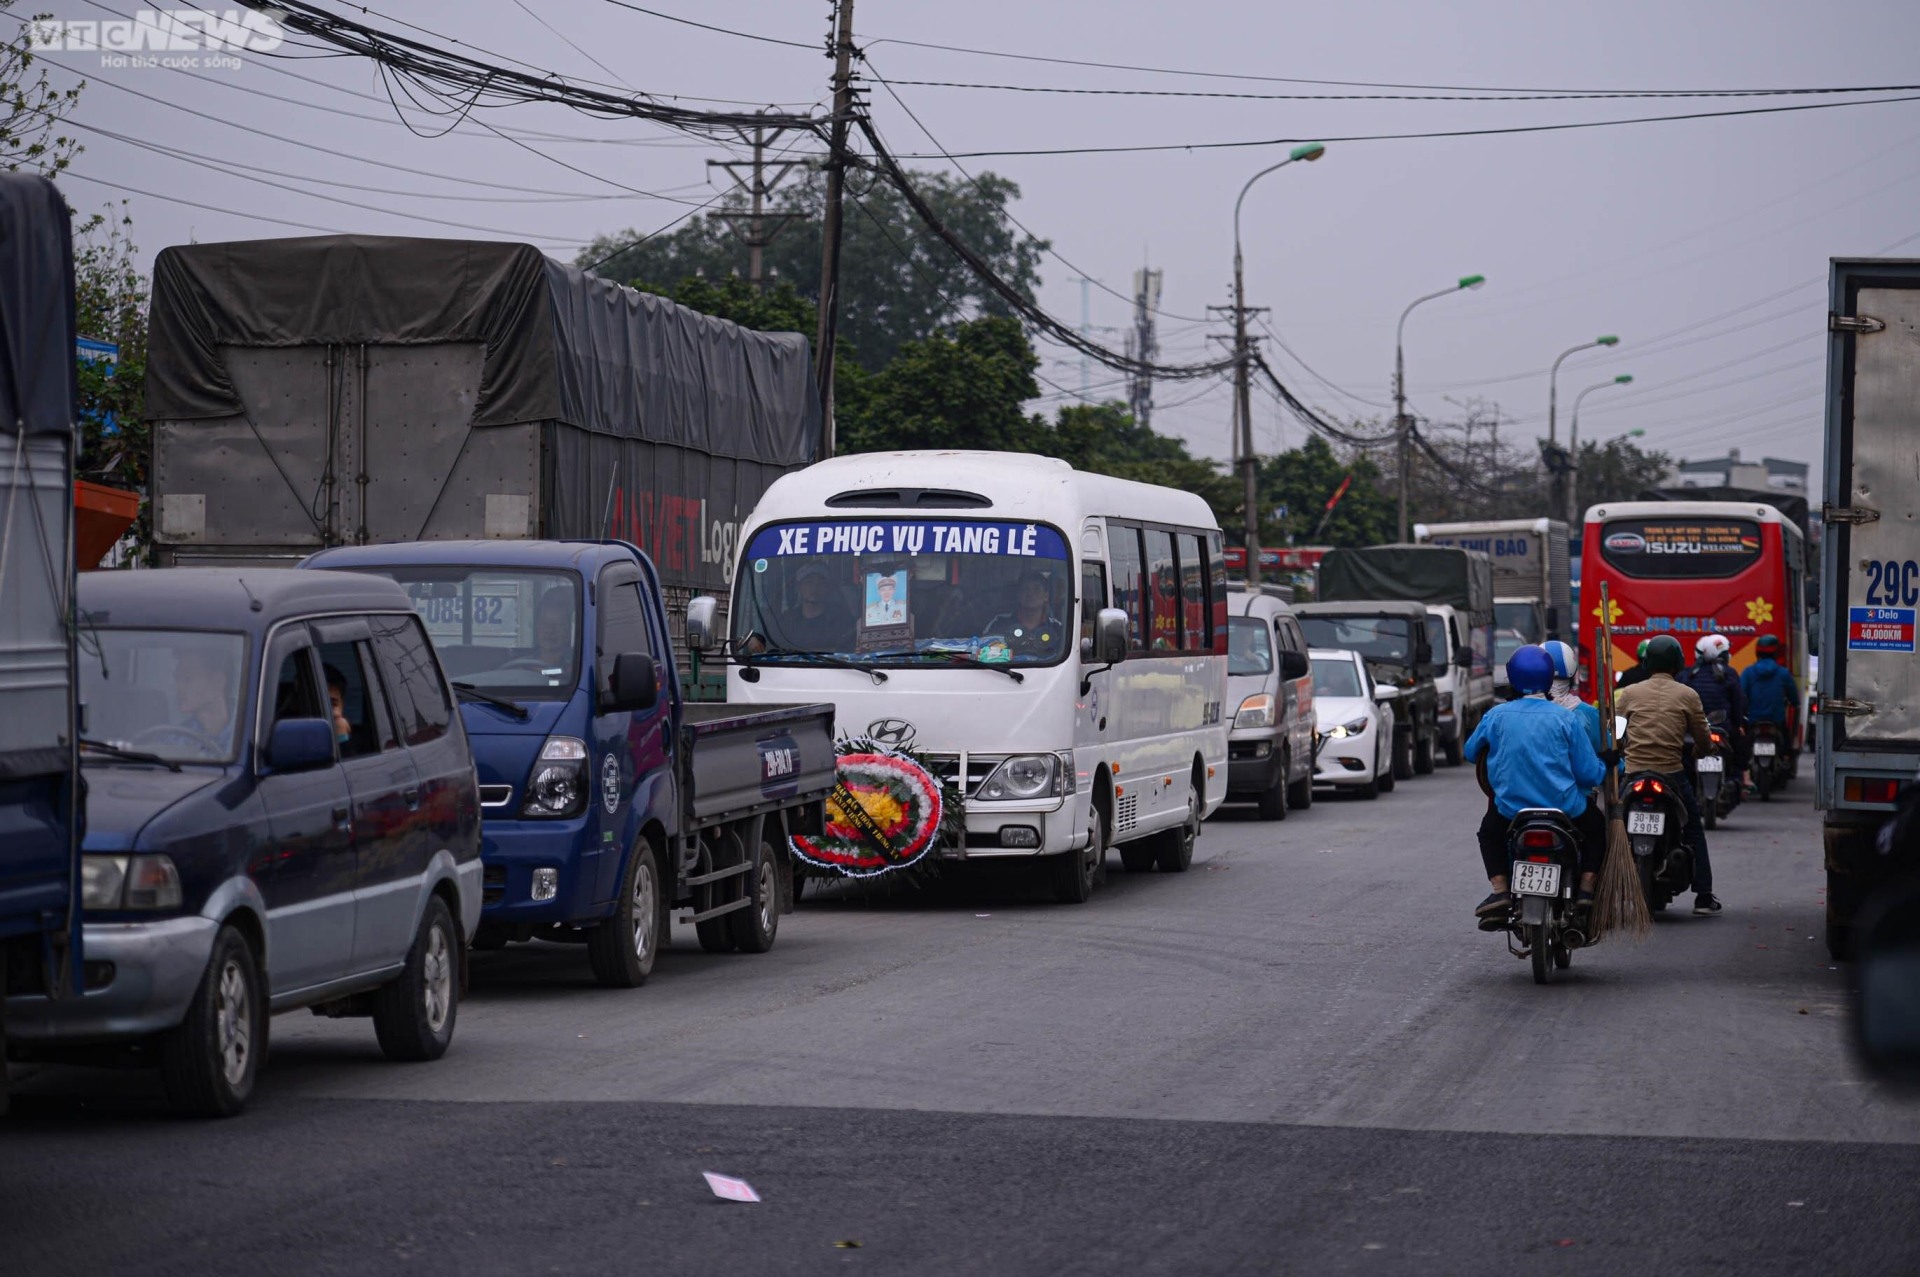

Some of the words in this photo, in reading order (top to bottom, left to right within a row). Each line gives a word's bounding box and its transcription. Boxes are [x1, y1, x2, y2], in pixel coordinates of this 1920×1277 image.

[701, 498, 744, 585] Logi
[777, 528, 809, 555] XE
[816, 526, 884, 557] PHỤC
[892, 526, 925, 557] VỤ
[932, 527, 999, 555] TANG
[1007, 523, 1037, 556] LỄ
[1646, 542, 1701, 554] ISUZU
[1702, 544, 1744, 552] WELCOME
[1866, 560, 1919, 606] 29C
[1878, 609, 1899, 620] Delo
[1861, 629, 1902, 641] 40,000KM
[1632, 822, 1659, 833] 2905
[1519, 876, 1551, 892] 6478
